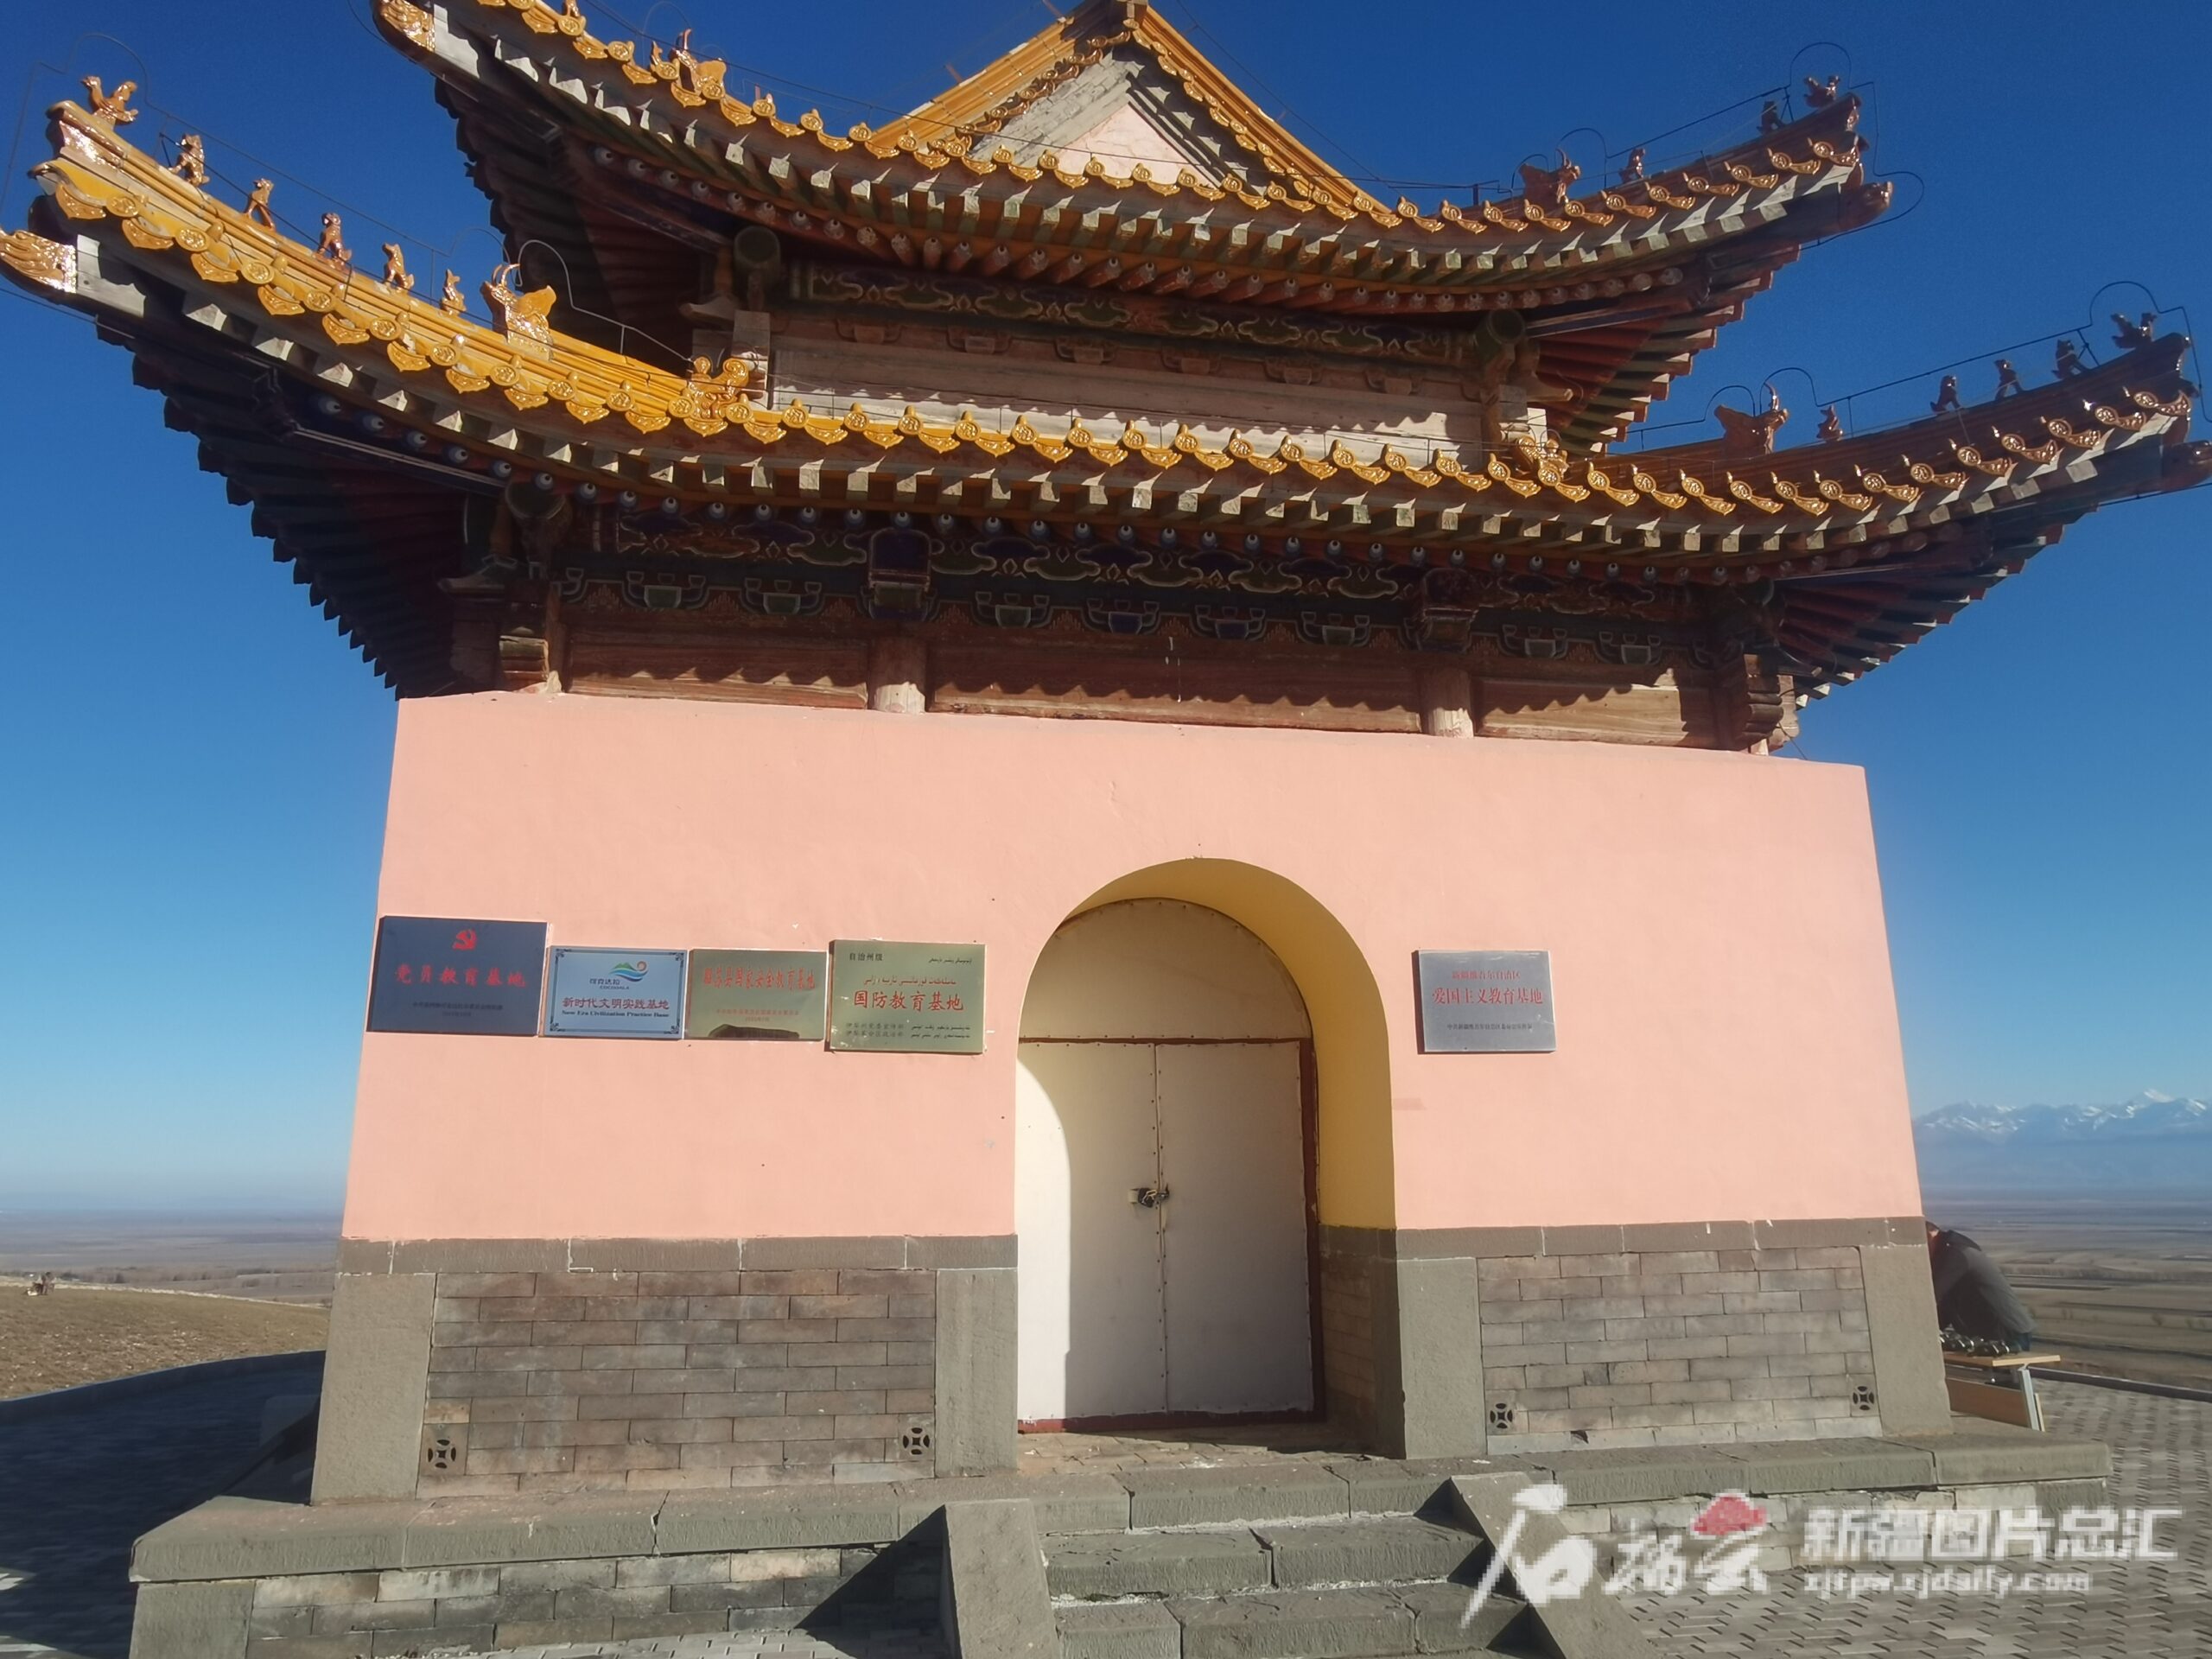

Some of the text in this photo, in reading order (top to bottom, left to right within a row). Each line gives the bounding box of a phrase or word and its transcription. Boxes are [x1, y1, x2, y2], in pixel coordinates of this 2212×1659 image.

[849, 952, 883, 962] 自治州级
[394, 963, 527, 988] 党员教育基地
[562, 996, 670, 1010] 新时代文明实践基地
[854, 989, 964, 1011] 国防教育基地
[1431, 987, 1544, 1005] 爱国主义教育基地
